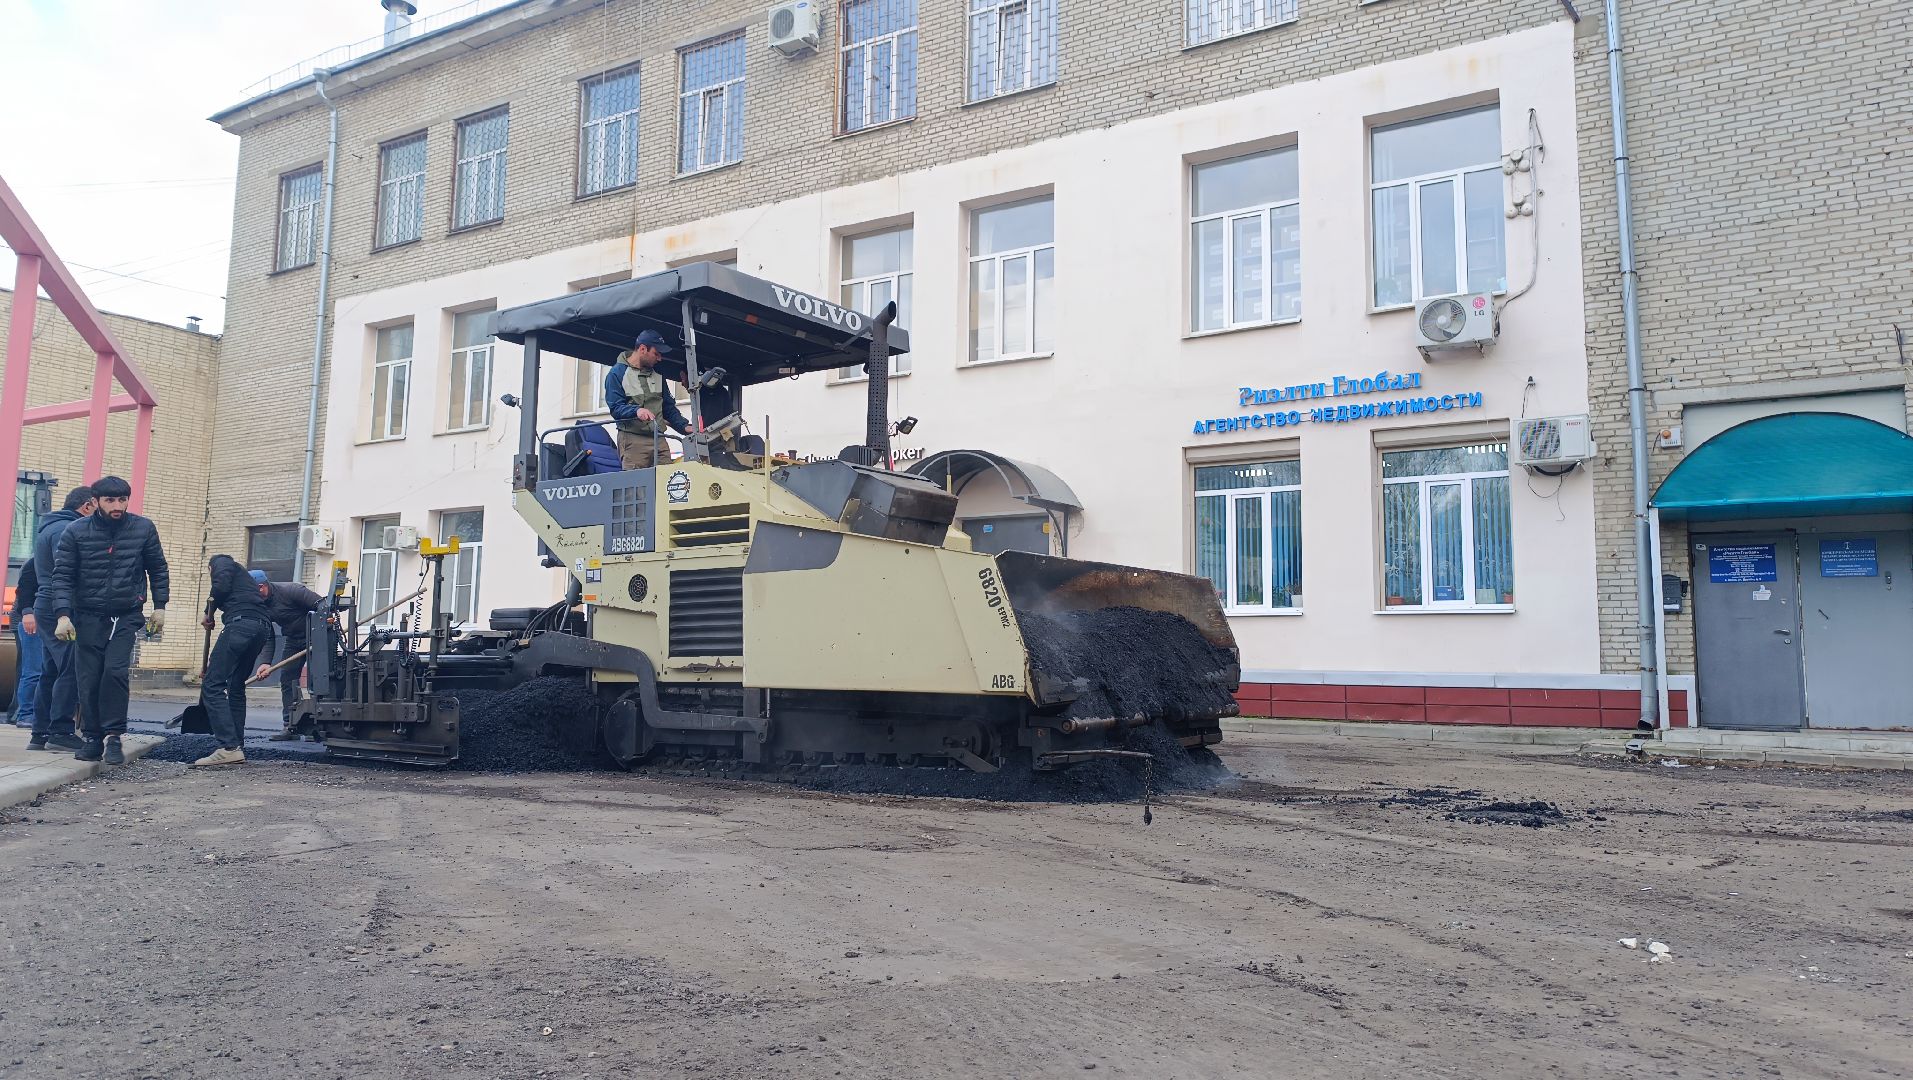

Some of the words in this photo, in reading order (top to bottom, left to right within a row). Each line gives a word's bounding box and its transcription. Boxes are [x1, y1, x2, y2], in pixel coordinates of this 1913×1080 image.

[771, 284, 862, 331] VOLVO
[1238, 382, 1326, 407] Риэлти
[1333, 371, 1422, 396] Глобал
[1193, 411, 1301, 435] АГЕНТСТВО
[1311, 392, 1483, 423] НЕДВИЖИМОСТИ
[543, 482, 602, 501] VOLVO
[611, 535, 645, 552] ABG6820
[978, 567, 1002, 608] 6820
[992, 674, 1015, 689] ABG
